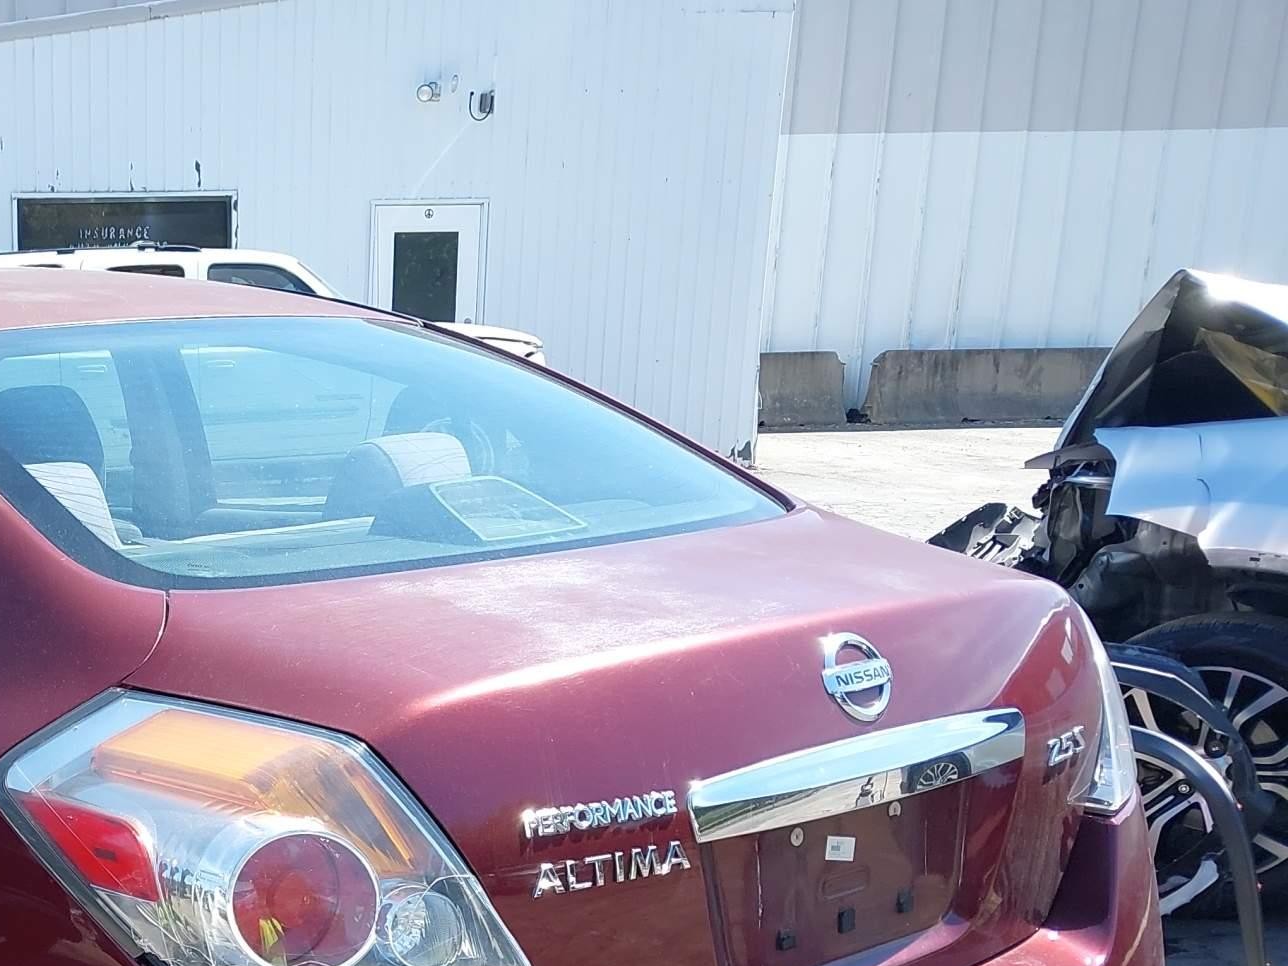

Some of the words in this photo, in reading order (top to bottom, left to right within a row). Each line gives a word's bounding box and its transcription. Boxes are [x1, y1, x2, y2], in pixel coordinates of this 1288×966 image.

[79, 226, 150, 240] INSURANCE
[835, 664, 890, 687] NISSAN
[521, 790, 678, 839] PERFORMANCE
[533, 841, 691, 898] ALTIMA
